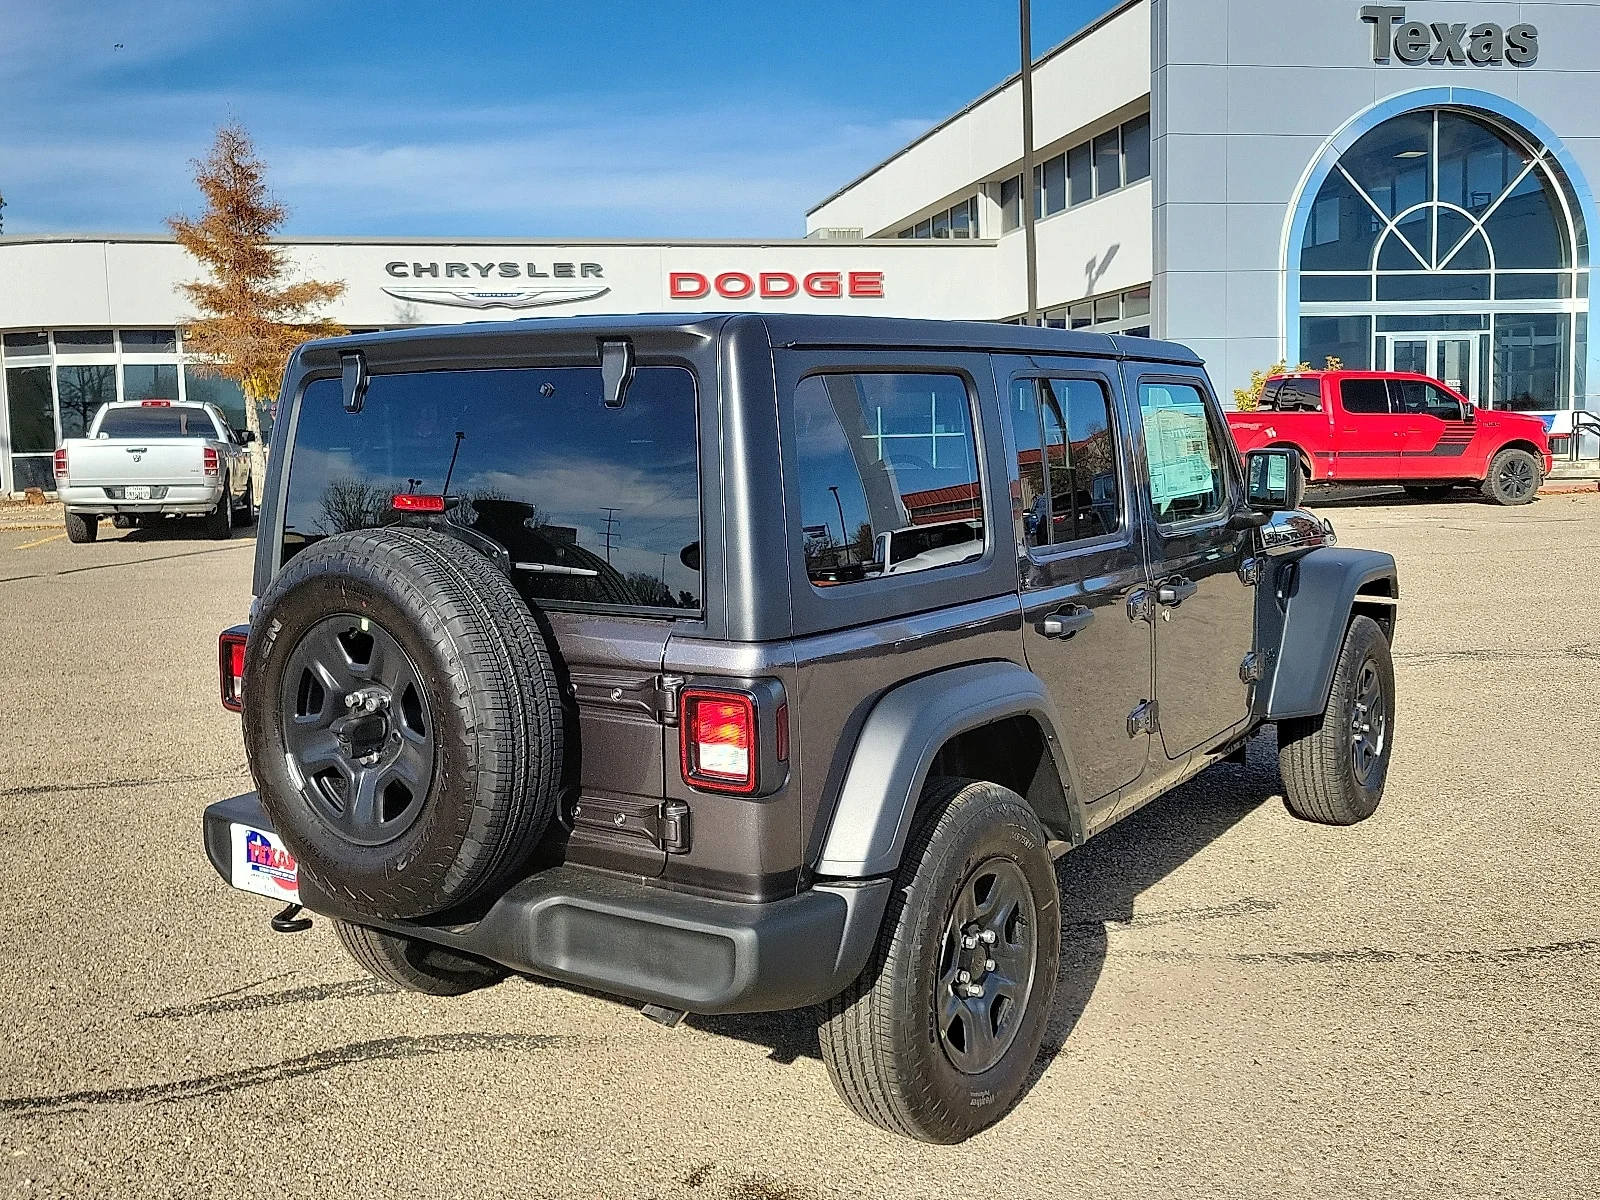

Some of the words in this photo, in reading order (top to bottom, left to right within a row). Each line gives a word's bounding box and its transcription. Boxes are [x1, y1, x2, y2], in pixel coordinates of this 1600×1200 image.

[1360, 6, 1539, 67] Texas
[385, 261, 604, 278] CHRYSLER
[669, 271, 884, 299] DODGE
[248, 841, 297, 872] TEXAS
